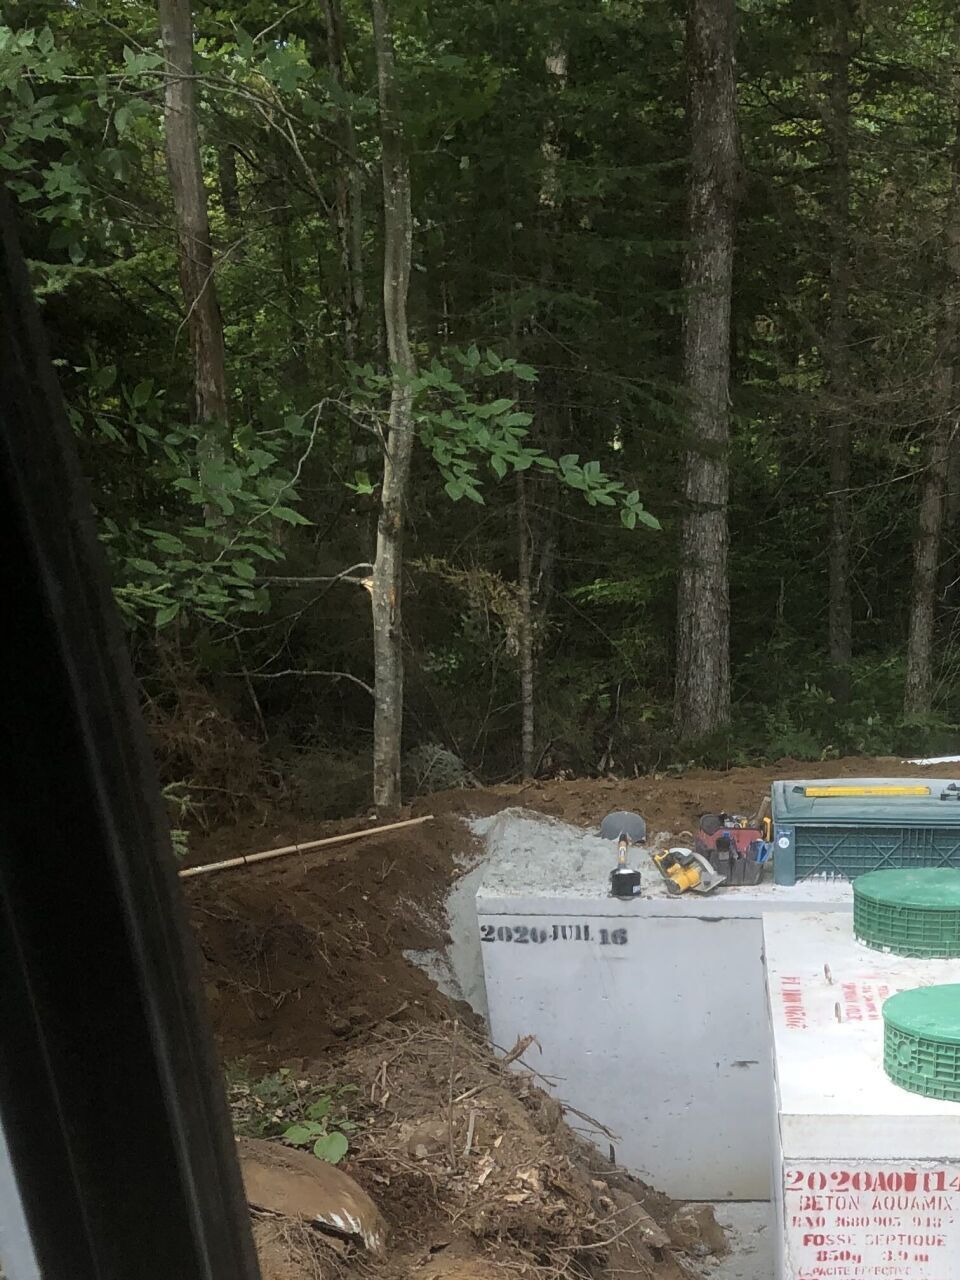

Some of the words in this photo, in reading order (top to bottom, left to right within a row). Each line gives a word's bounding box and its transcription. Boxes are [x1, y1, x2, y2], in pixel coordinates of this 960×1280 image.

[480, 924, 548, 944] 2020
[599, 927, 628, 945] 16
[803, 1234, 857, 1247] FOSSE
[865, 1234, 947, 1247] SEPTIQUE
